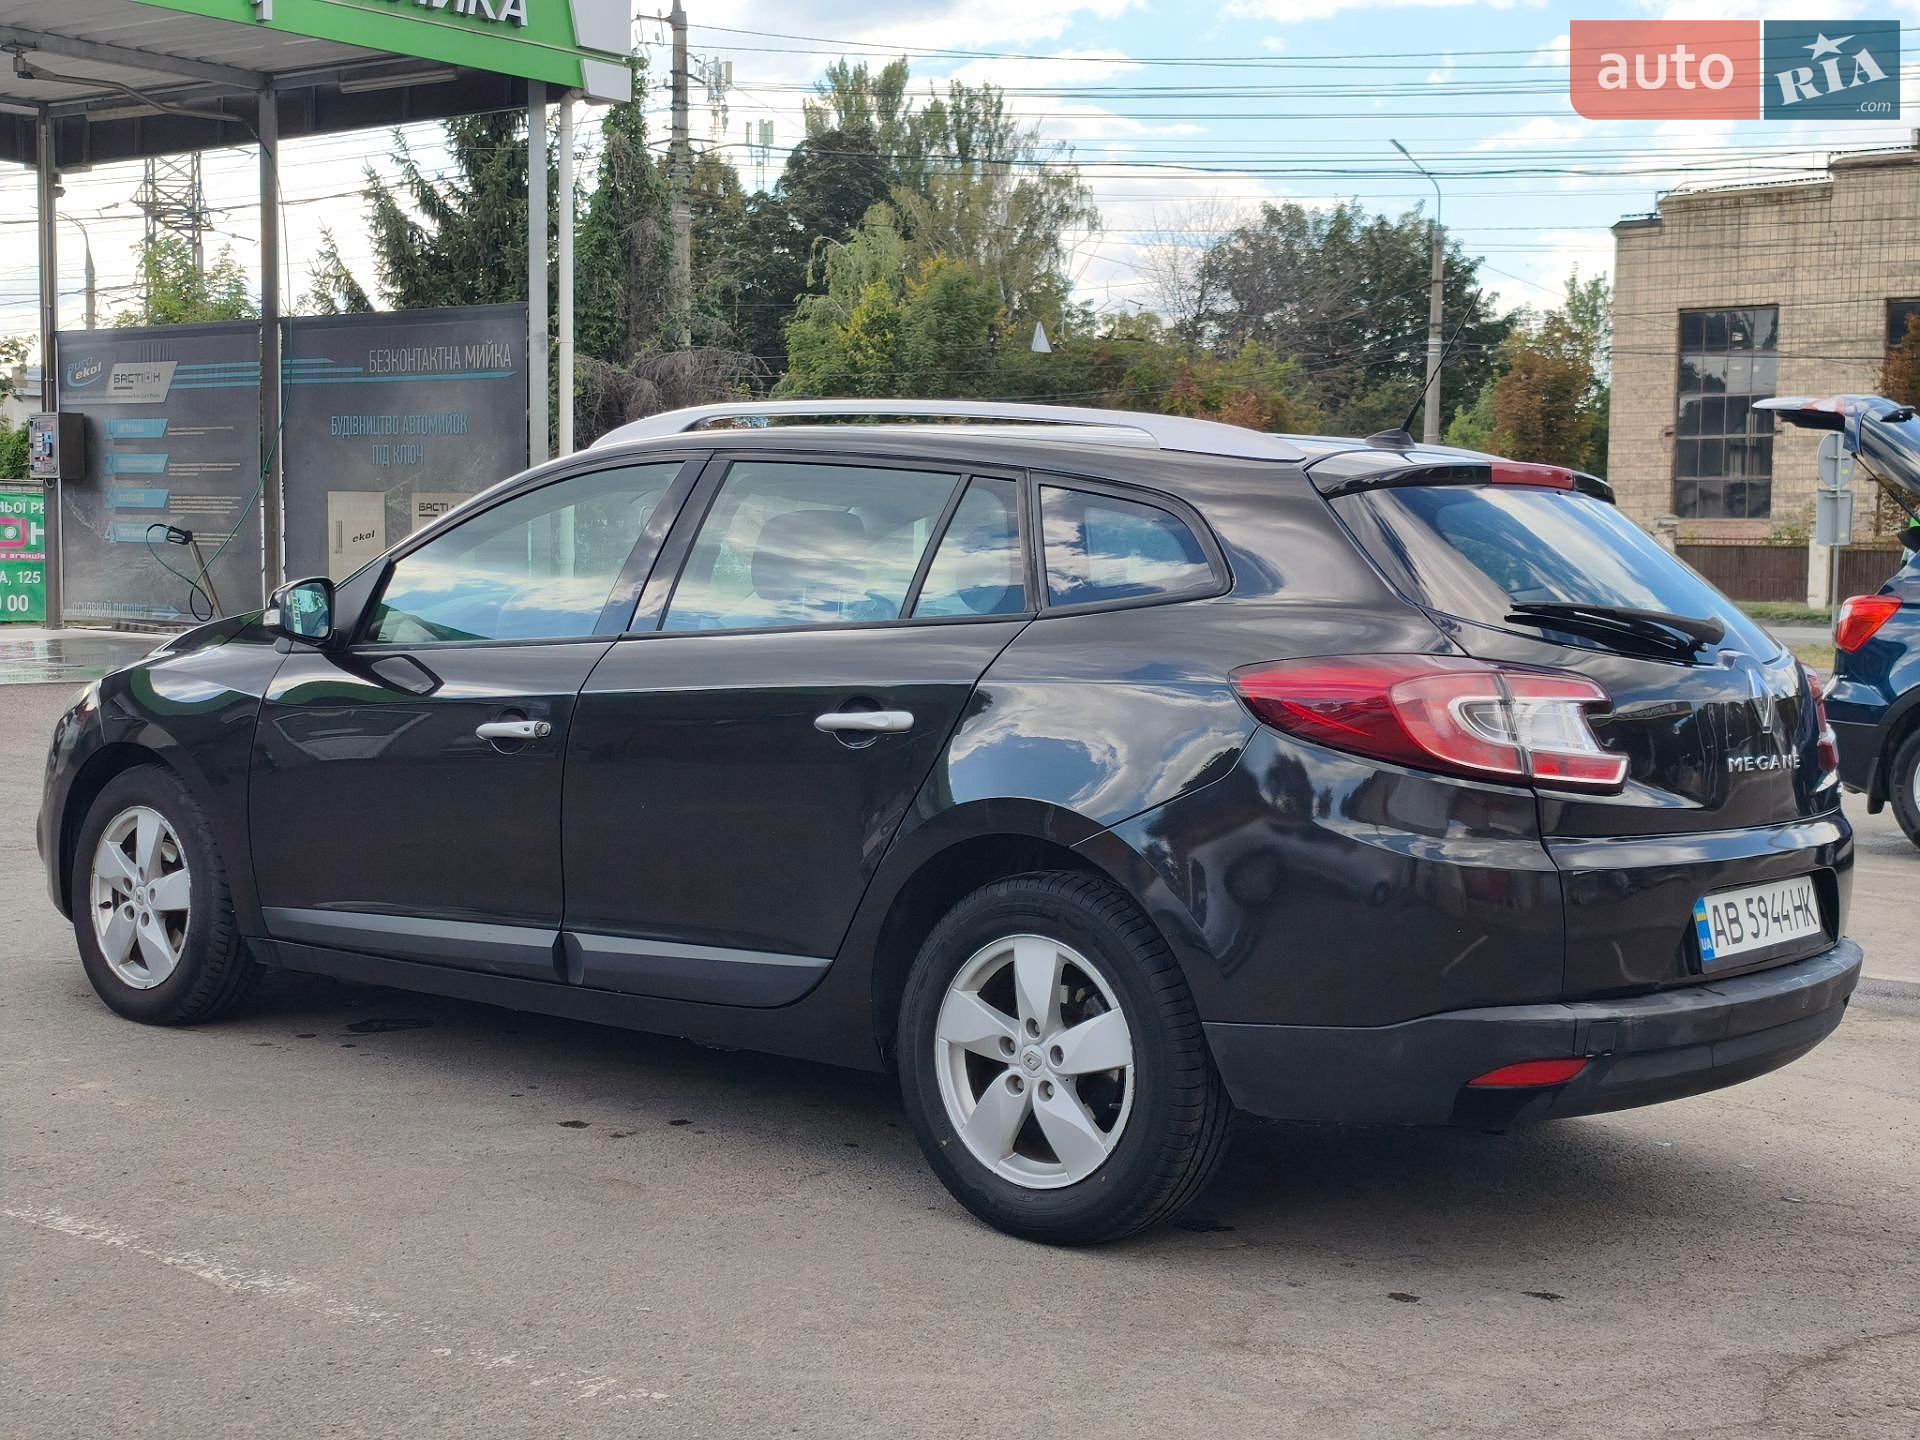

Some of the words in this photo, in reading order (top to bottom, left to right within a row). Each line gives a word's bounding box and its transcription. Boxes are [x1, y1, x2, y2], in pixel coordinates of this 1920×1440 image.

[369, 346, 461, 373] БЕЗКОНТАКТНА
[465, 339, 512, 369] МИЙКА
[75, 361, 102, 380] ekol
[331, 415, 399, 438] БУДІВНИЦТВО
[402, 411, 468, 435] АВТОМИЙОК
[372, 444, 390, 467] ПІД
[393, 443, 424, 465] КЛЮЧ
[352, 530, 375, 542] ekol
[17, 571, 41, 584] 125
[1728, 754, 1801, 773] MEGANE
[1712, 902, 1744, 948] AB
